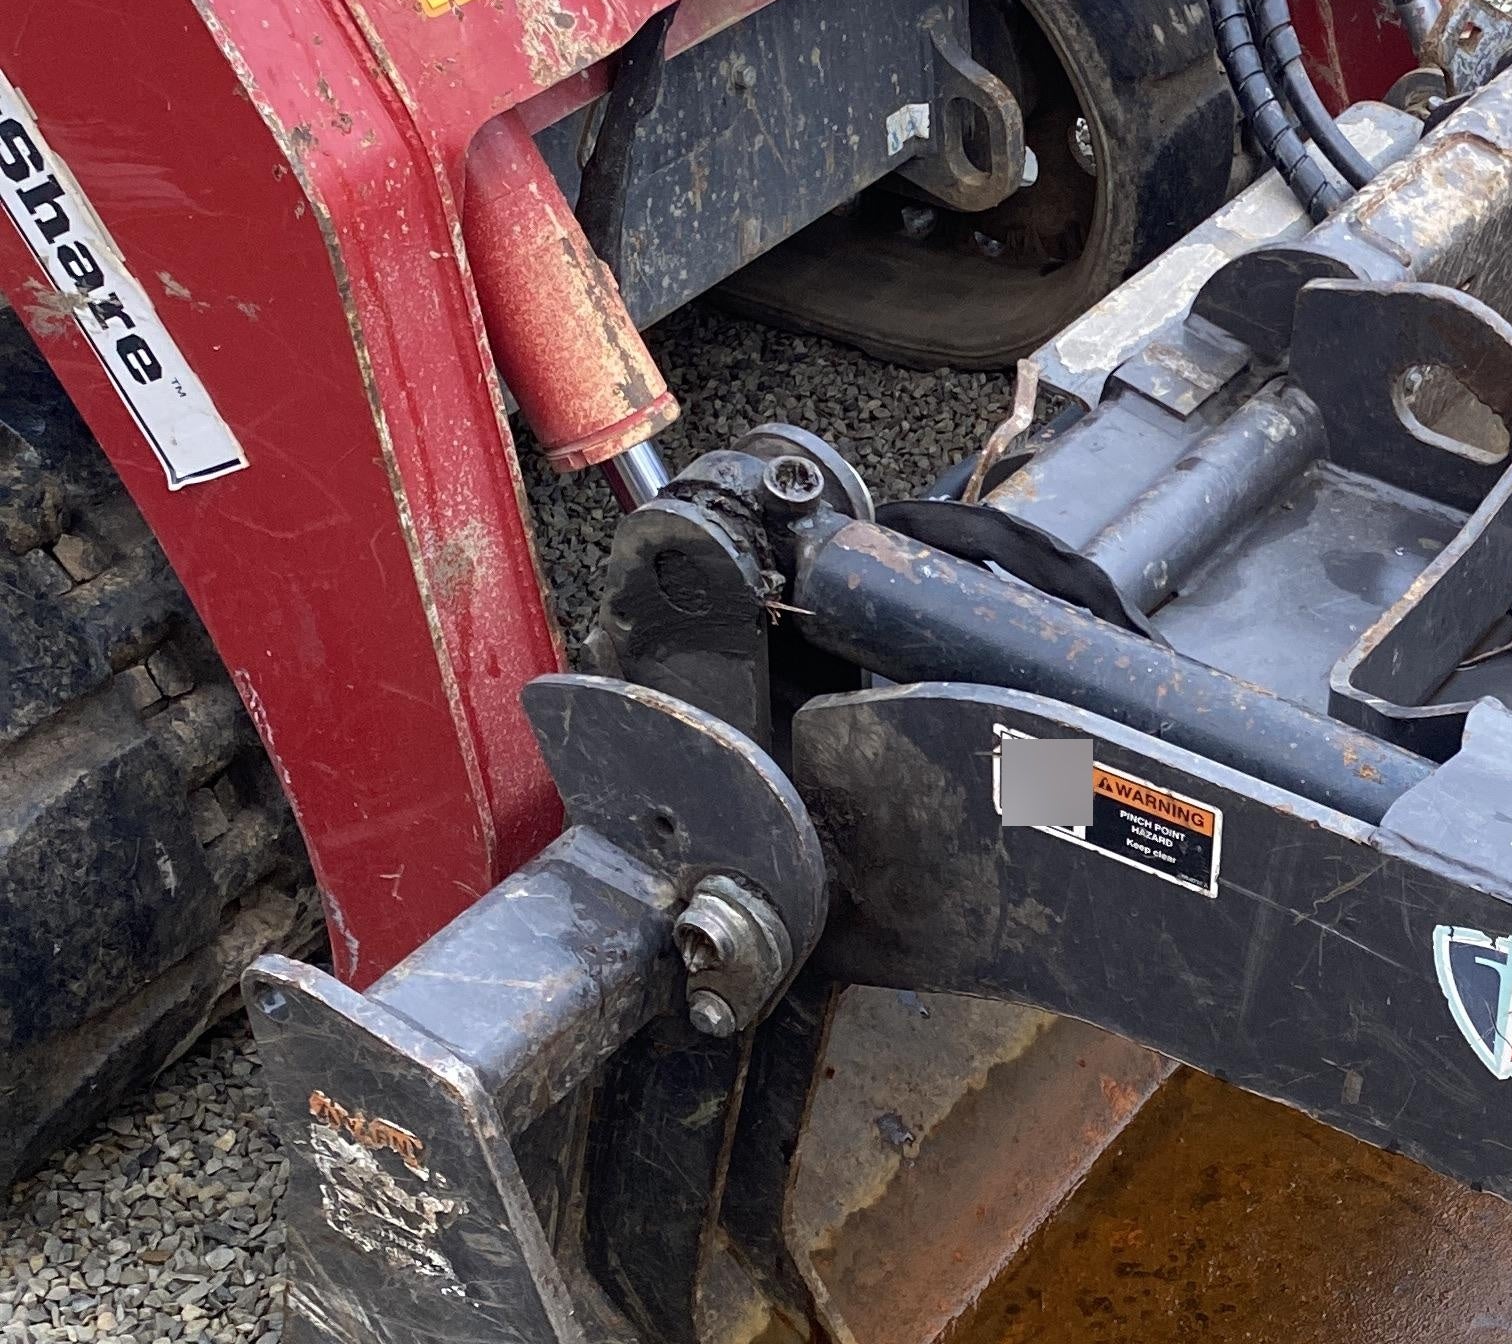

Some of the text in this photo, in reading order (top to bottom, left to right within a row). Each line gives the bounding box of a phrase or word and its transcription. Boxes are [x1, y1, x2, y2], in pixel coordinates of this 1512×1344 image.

[1115, 781, 1205, 828] WARNING
[1120, 809, 1186, 842] PINCH POINT
[1131, 825, 1174, 848] HAZARD
[1126, 838, 1177, 864] Keep clear
